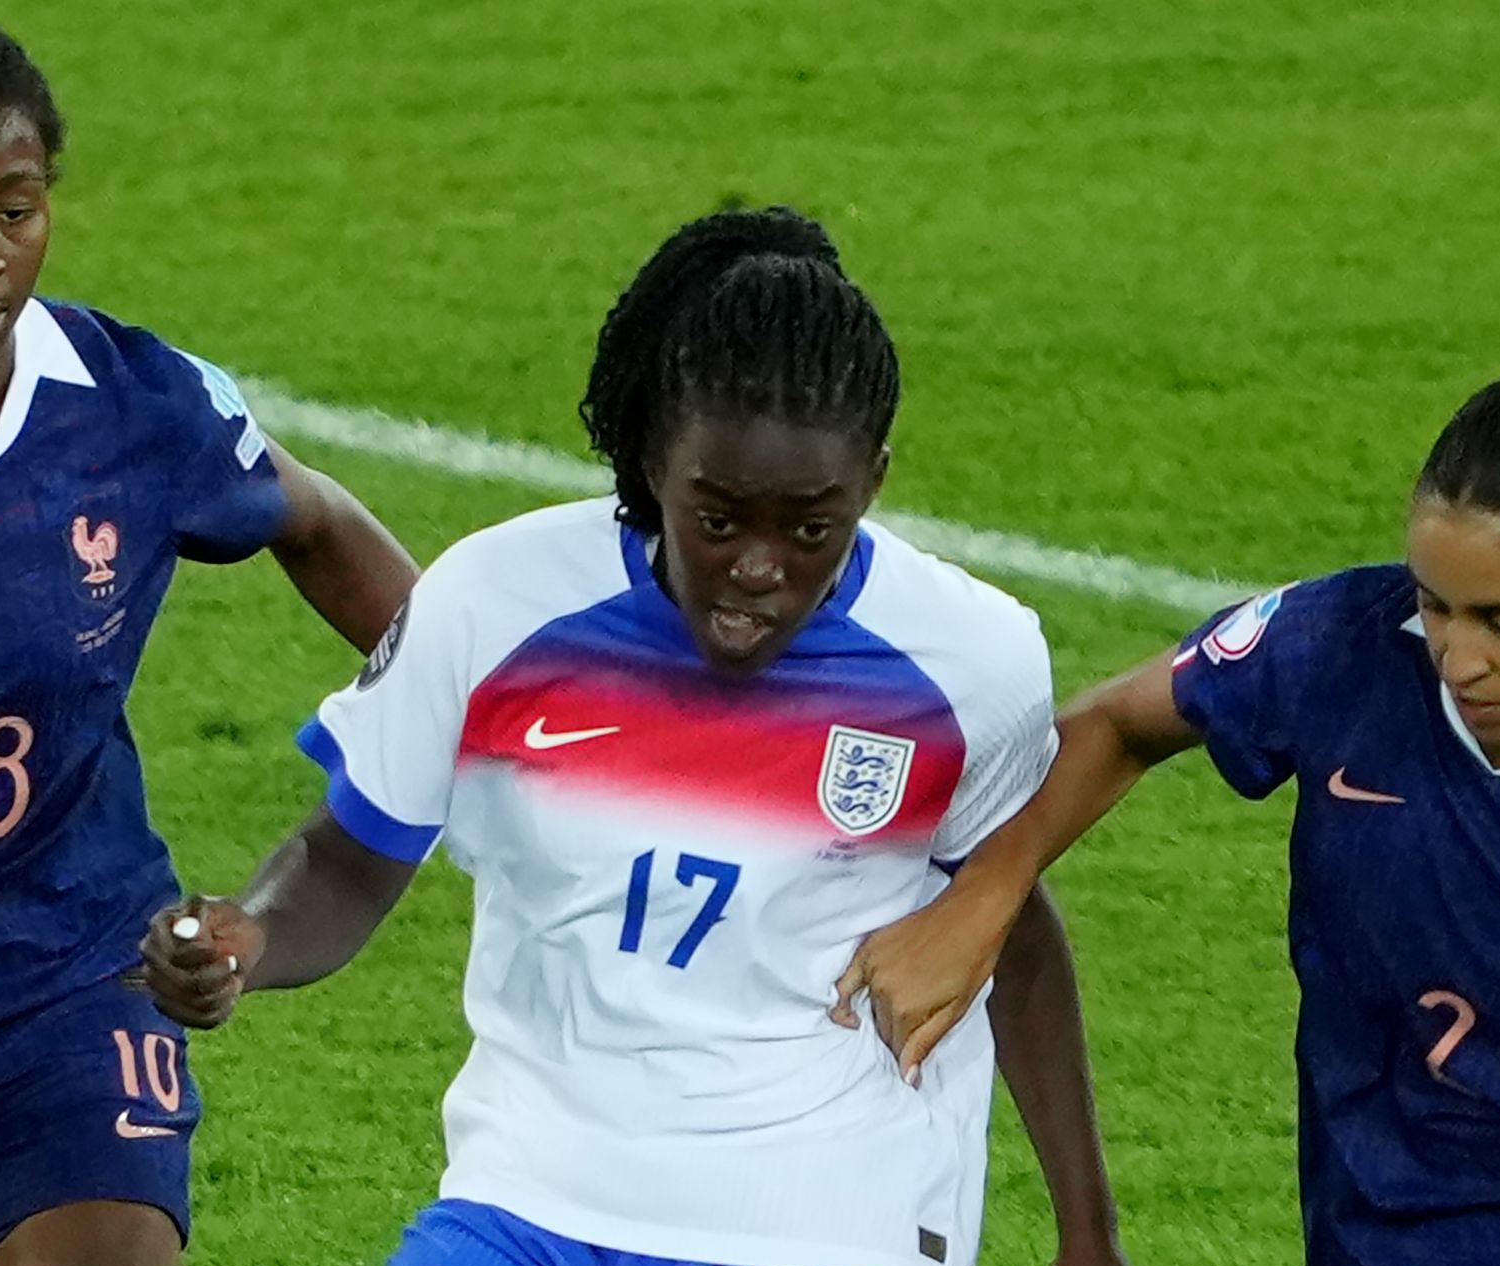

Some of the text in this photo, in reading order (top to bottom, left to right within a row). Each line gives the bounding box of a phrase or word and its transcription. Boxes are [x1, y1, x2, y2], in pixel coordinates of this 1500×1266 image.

[618, 848, 742, 970] 17
[114, 1029, 180, 1112] 10
[1417, 989, 1481, 1097] 2
